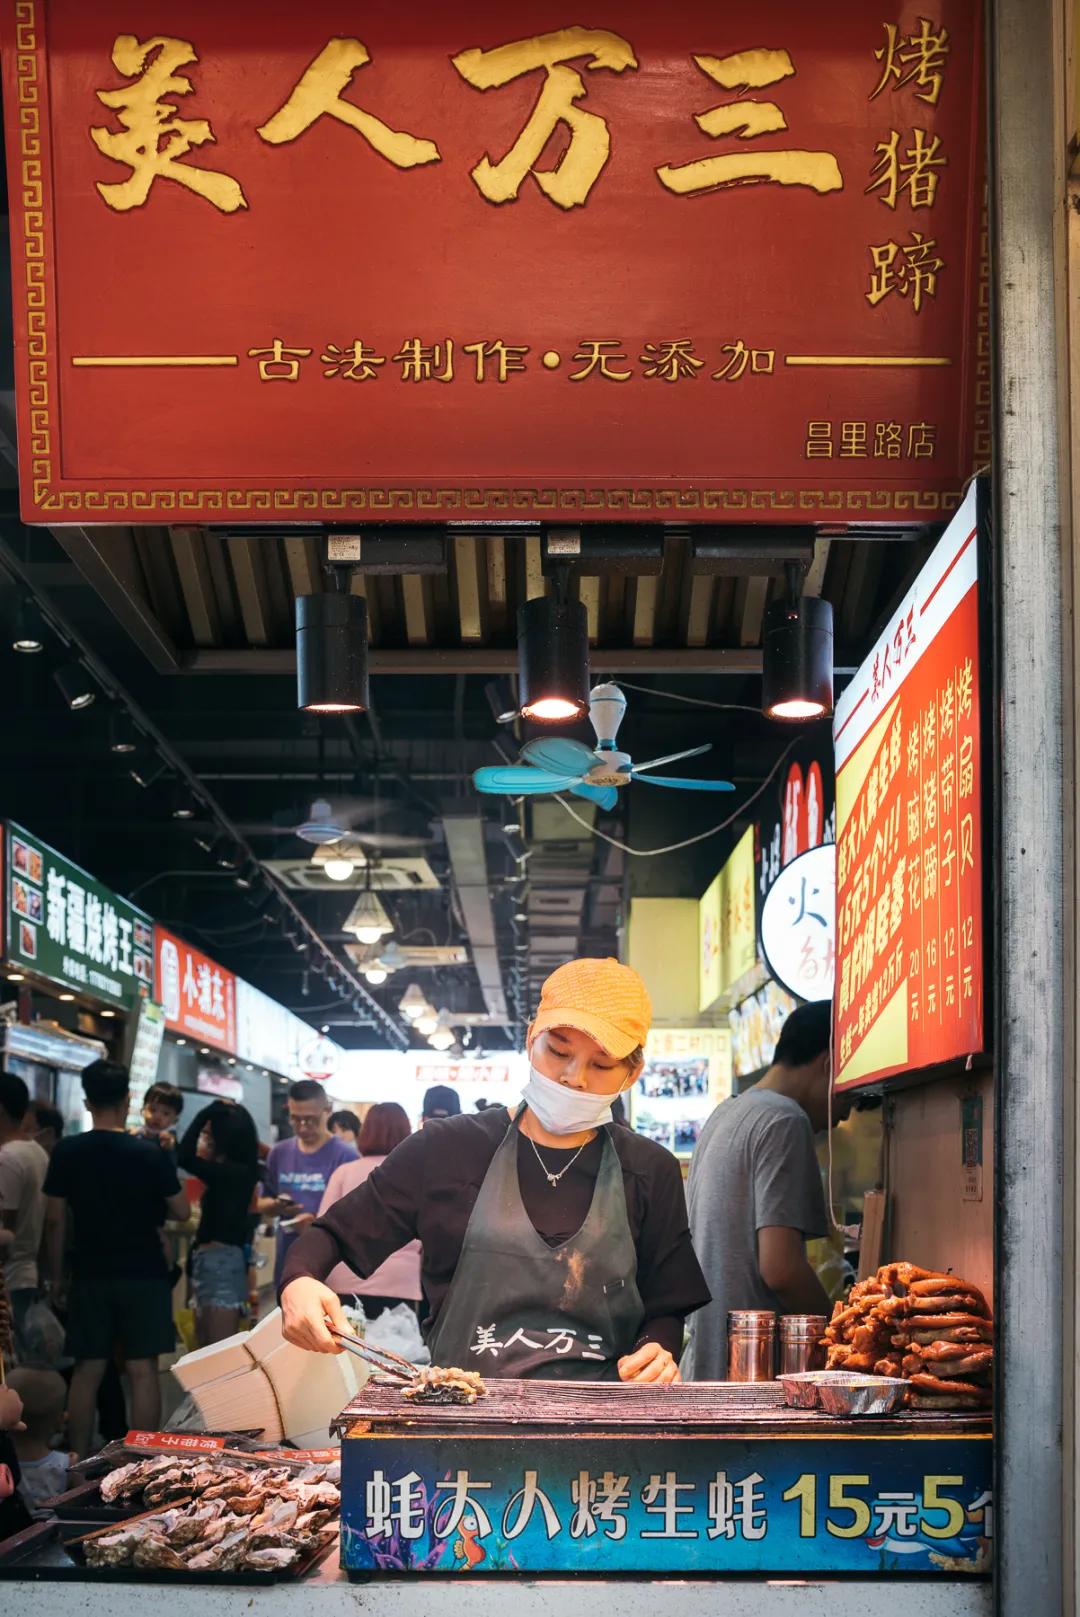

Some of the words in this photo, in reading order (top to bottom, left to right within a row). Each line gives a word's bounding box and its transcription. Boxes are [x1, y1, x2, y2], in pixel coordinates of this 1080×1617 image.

[91, 26, 843, 212] 美人万三
[865, 18, 949, 312] 烤猪蹄
[805, 421, 936, 459] 昌里路店
[469, 1323, 606, 1360] 美人万三
